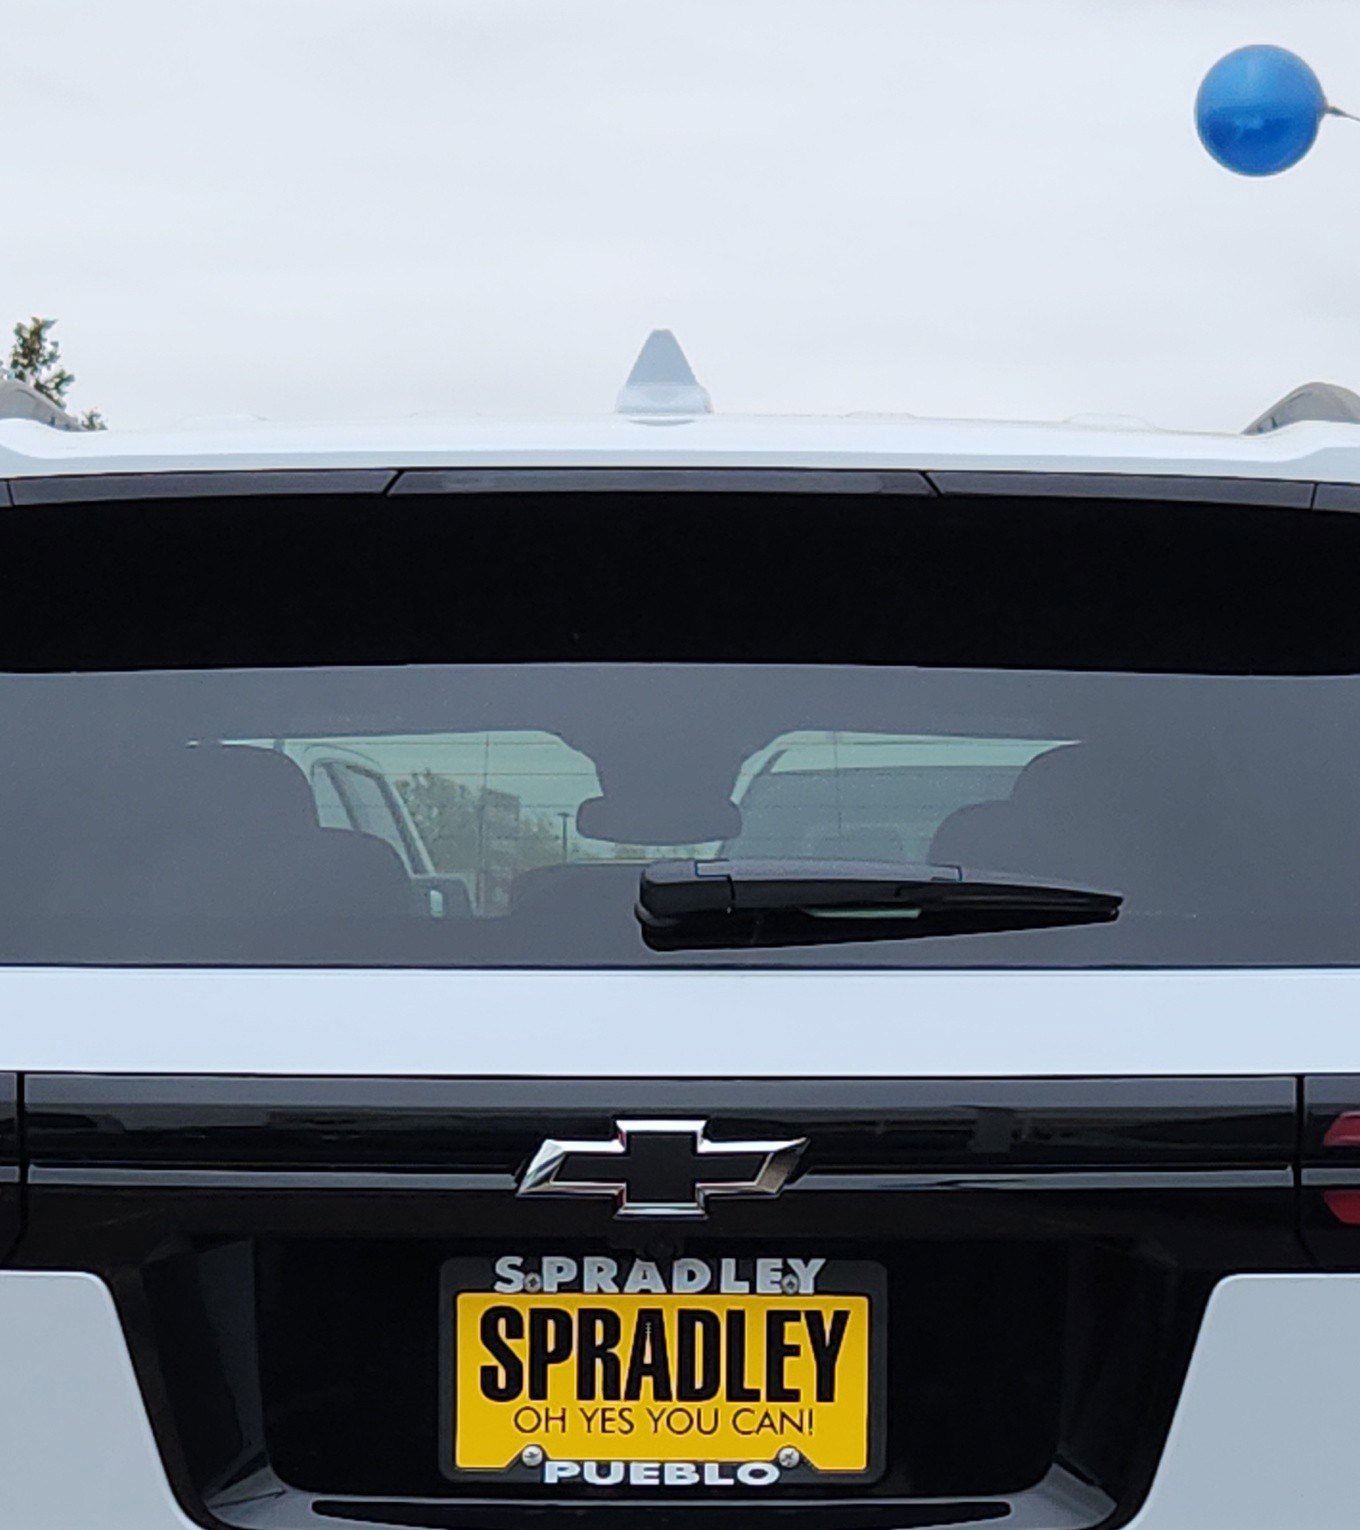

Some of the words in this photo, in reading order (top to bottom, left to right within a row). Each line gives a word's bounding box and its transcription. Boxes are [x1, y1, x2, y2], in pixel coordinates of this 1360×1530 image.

[493, 1255, 827, 1295] SPRADLEY
[478, 1305, 851, 1403] SPRADLEY
[513, 1406, 567, 1434] OH
[579, 1407, 635, 1434] YES
[650, 1408, 719, 1436] YOU
[732, 1408, 814, 1436] CAN!
[543, 1461, 780, 1486] PUEBLO
